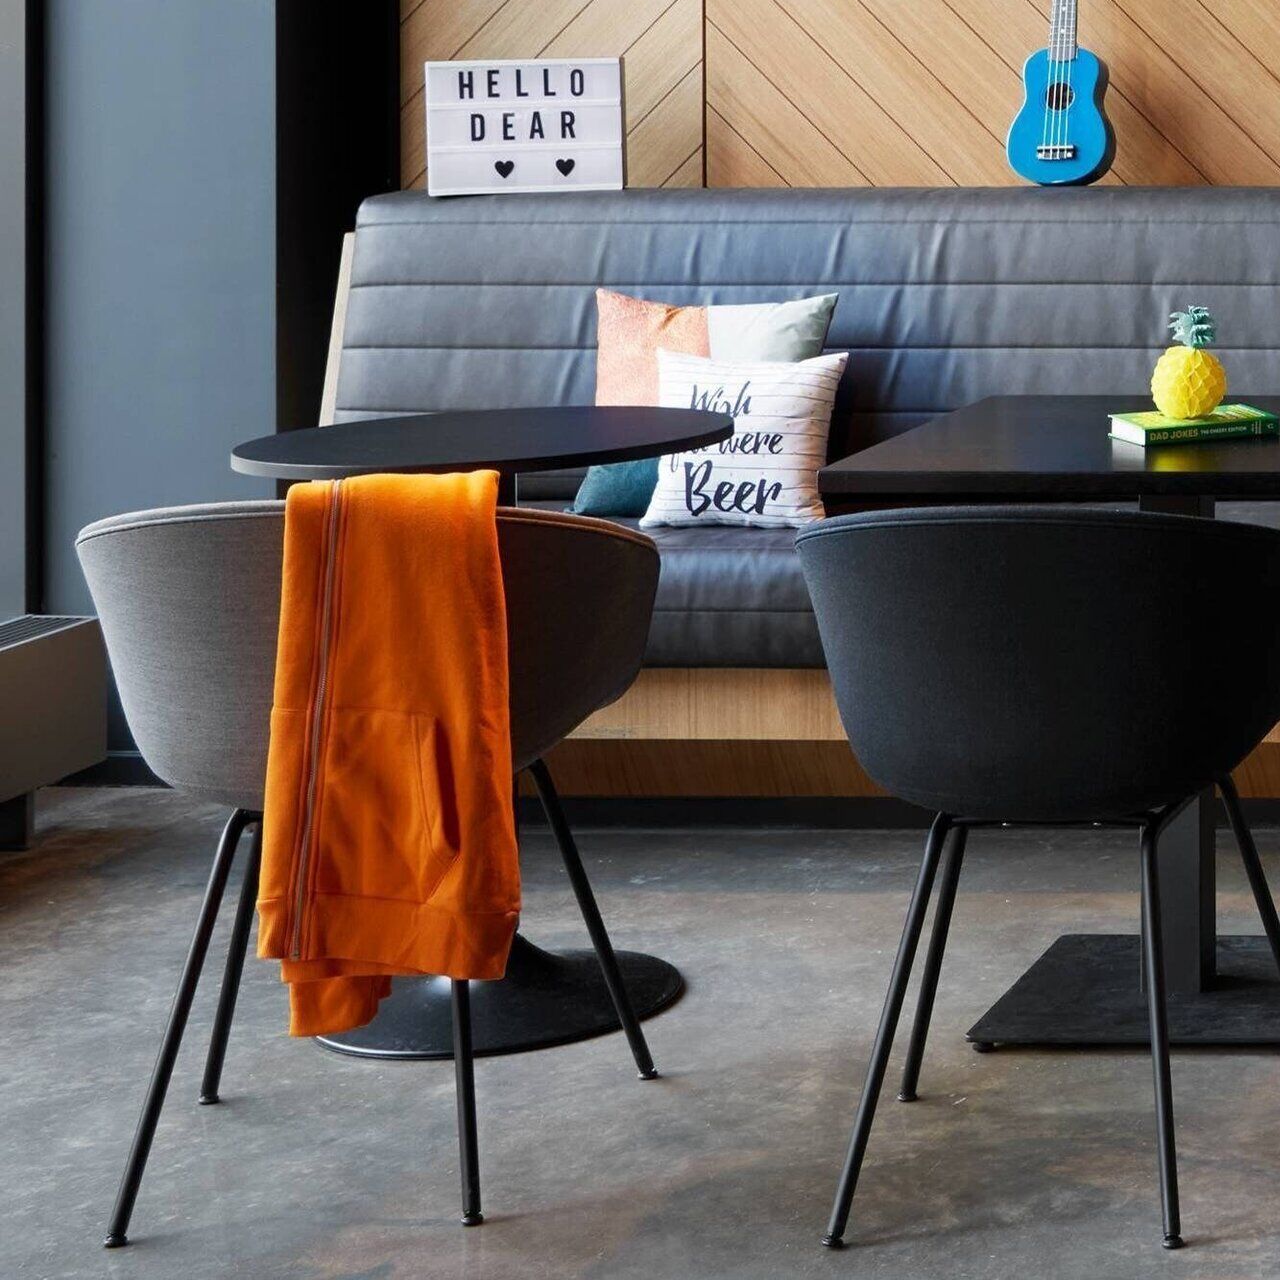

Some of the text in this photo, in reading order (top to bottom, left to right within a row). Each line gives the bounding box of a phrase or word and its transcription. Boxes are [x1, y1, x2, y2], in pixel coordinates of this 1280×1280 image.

[458, 68, 585, 100] HELLO
[470, 110, 577, 142] DEAR
[690, 380, 752, 418] Wish
[1149, 431, 1169, 441] DAD
[1170, 428, 1199, 440] JOKES
[684, 459, 783, 517] Beer
